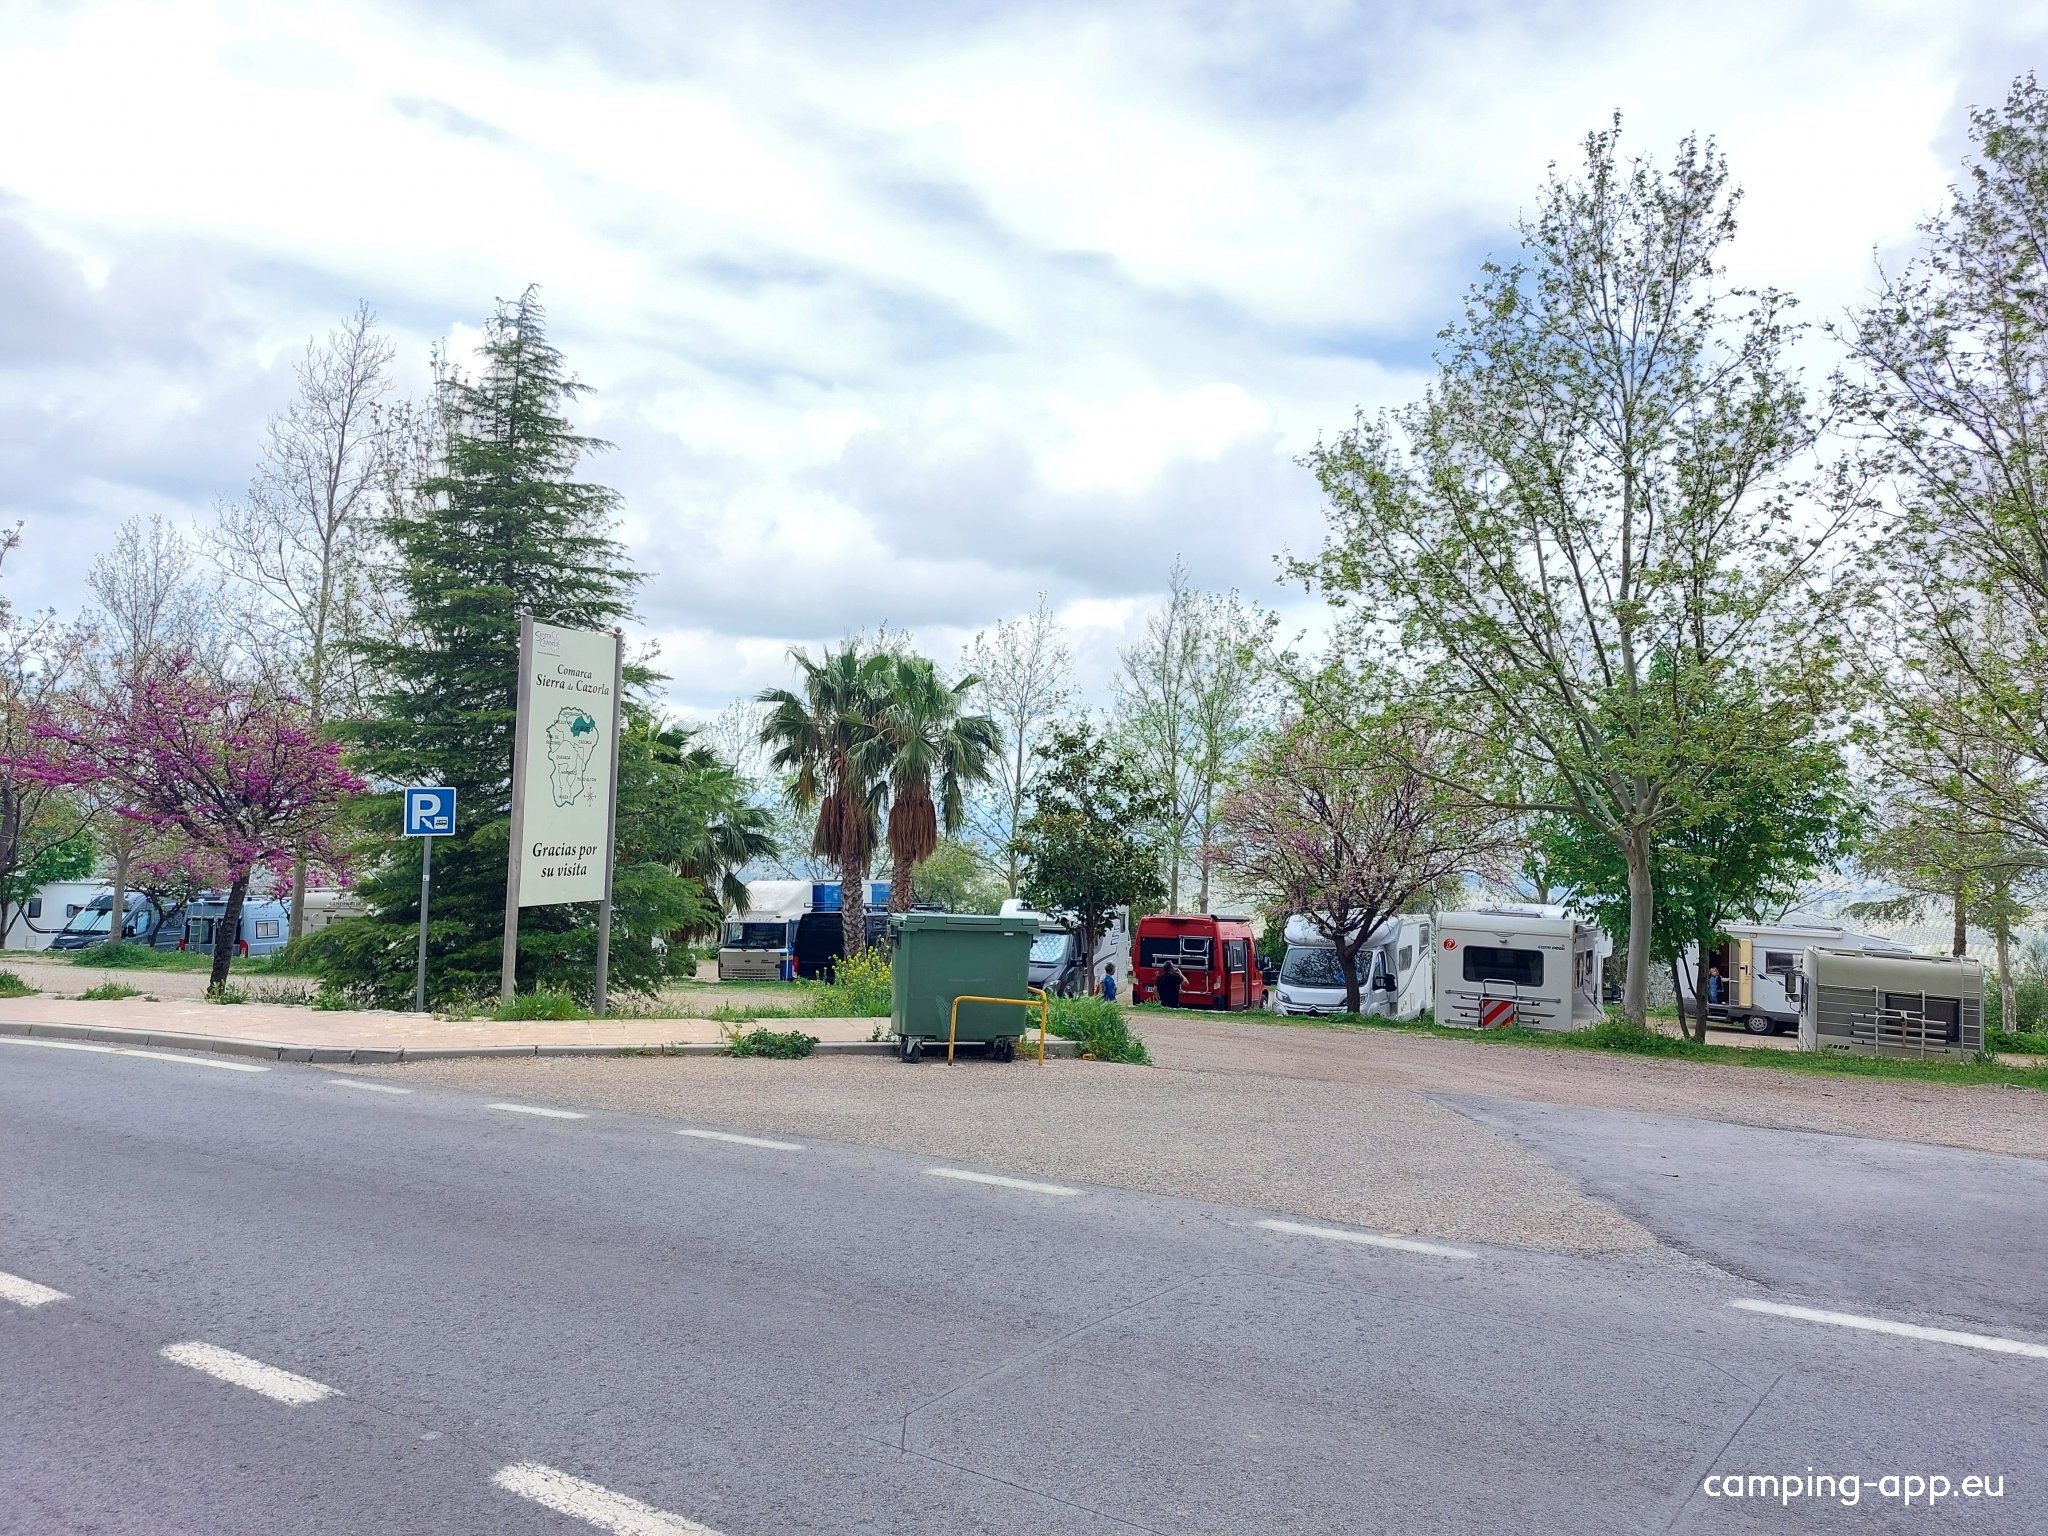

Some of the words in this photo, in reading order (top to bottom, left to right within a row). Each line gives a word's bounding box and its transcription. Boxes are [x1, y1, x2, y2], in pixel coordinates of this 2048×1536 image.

[557, 663, 592, 679] Comarca
[536, 674, 565, 690] Sierra
[567, 683, 574, 691] de
[576, 680, 609, 696] Cazorla
[411, 793, 441, 830] P
[532, 842, 577, 857] Gracias
[577, 844, 598, 860] por
[541, 866, 554, 878] su
[557, 862, 587, 877] visita
